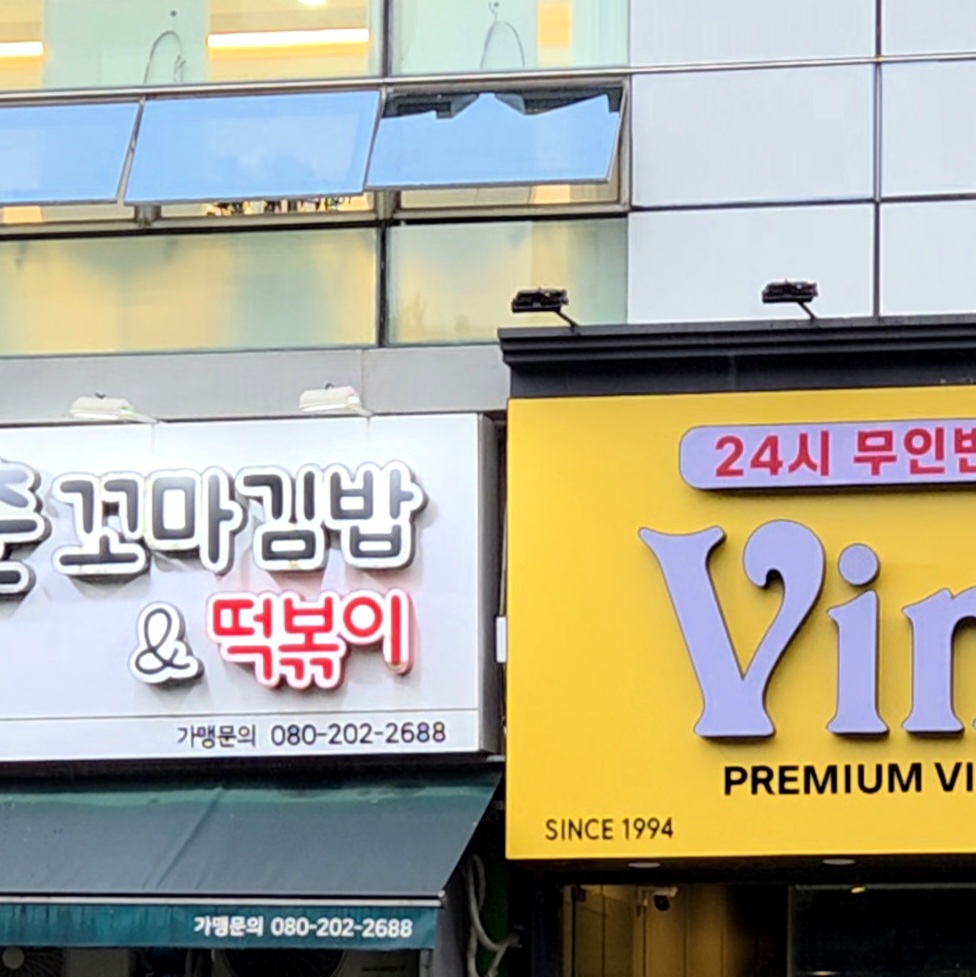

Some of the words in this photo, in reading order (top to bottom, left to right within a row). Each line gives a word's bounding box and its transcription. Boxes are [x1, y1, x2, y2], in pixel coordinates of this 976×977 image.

[714, 430, 830, 478] 24시
[207, 589, 415, 690] 떡볶이
[177, 724, 257, 749] 가맹문의
[270, 720, 447, 747] 080-202-2688
[723, 763, 923, 797] PREMIUM
[545, 818, 614, 841] SINCE
[621, 816, 674, 840] 1994
[193, 915, 264, 938] 가맹문의
[270, 916, 414, 939] 080-202-2688
